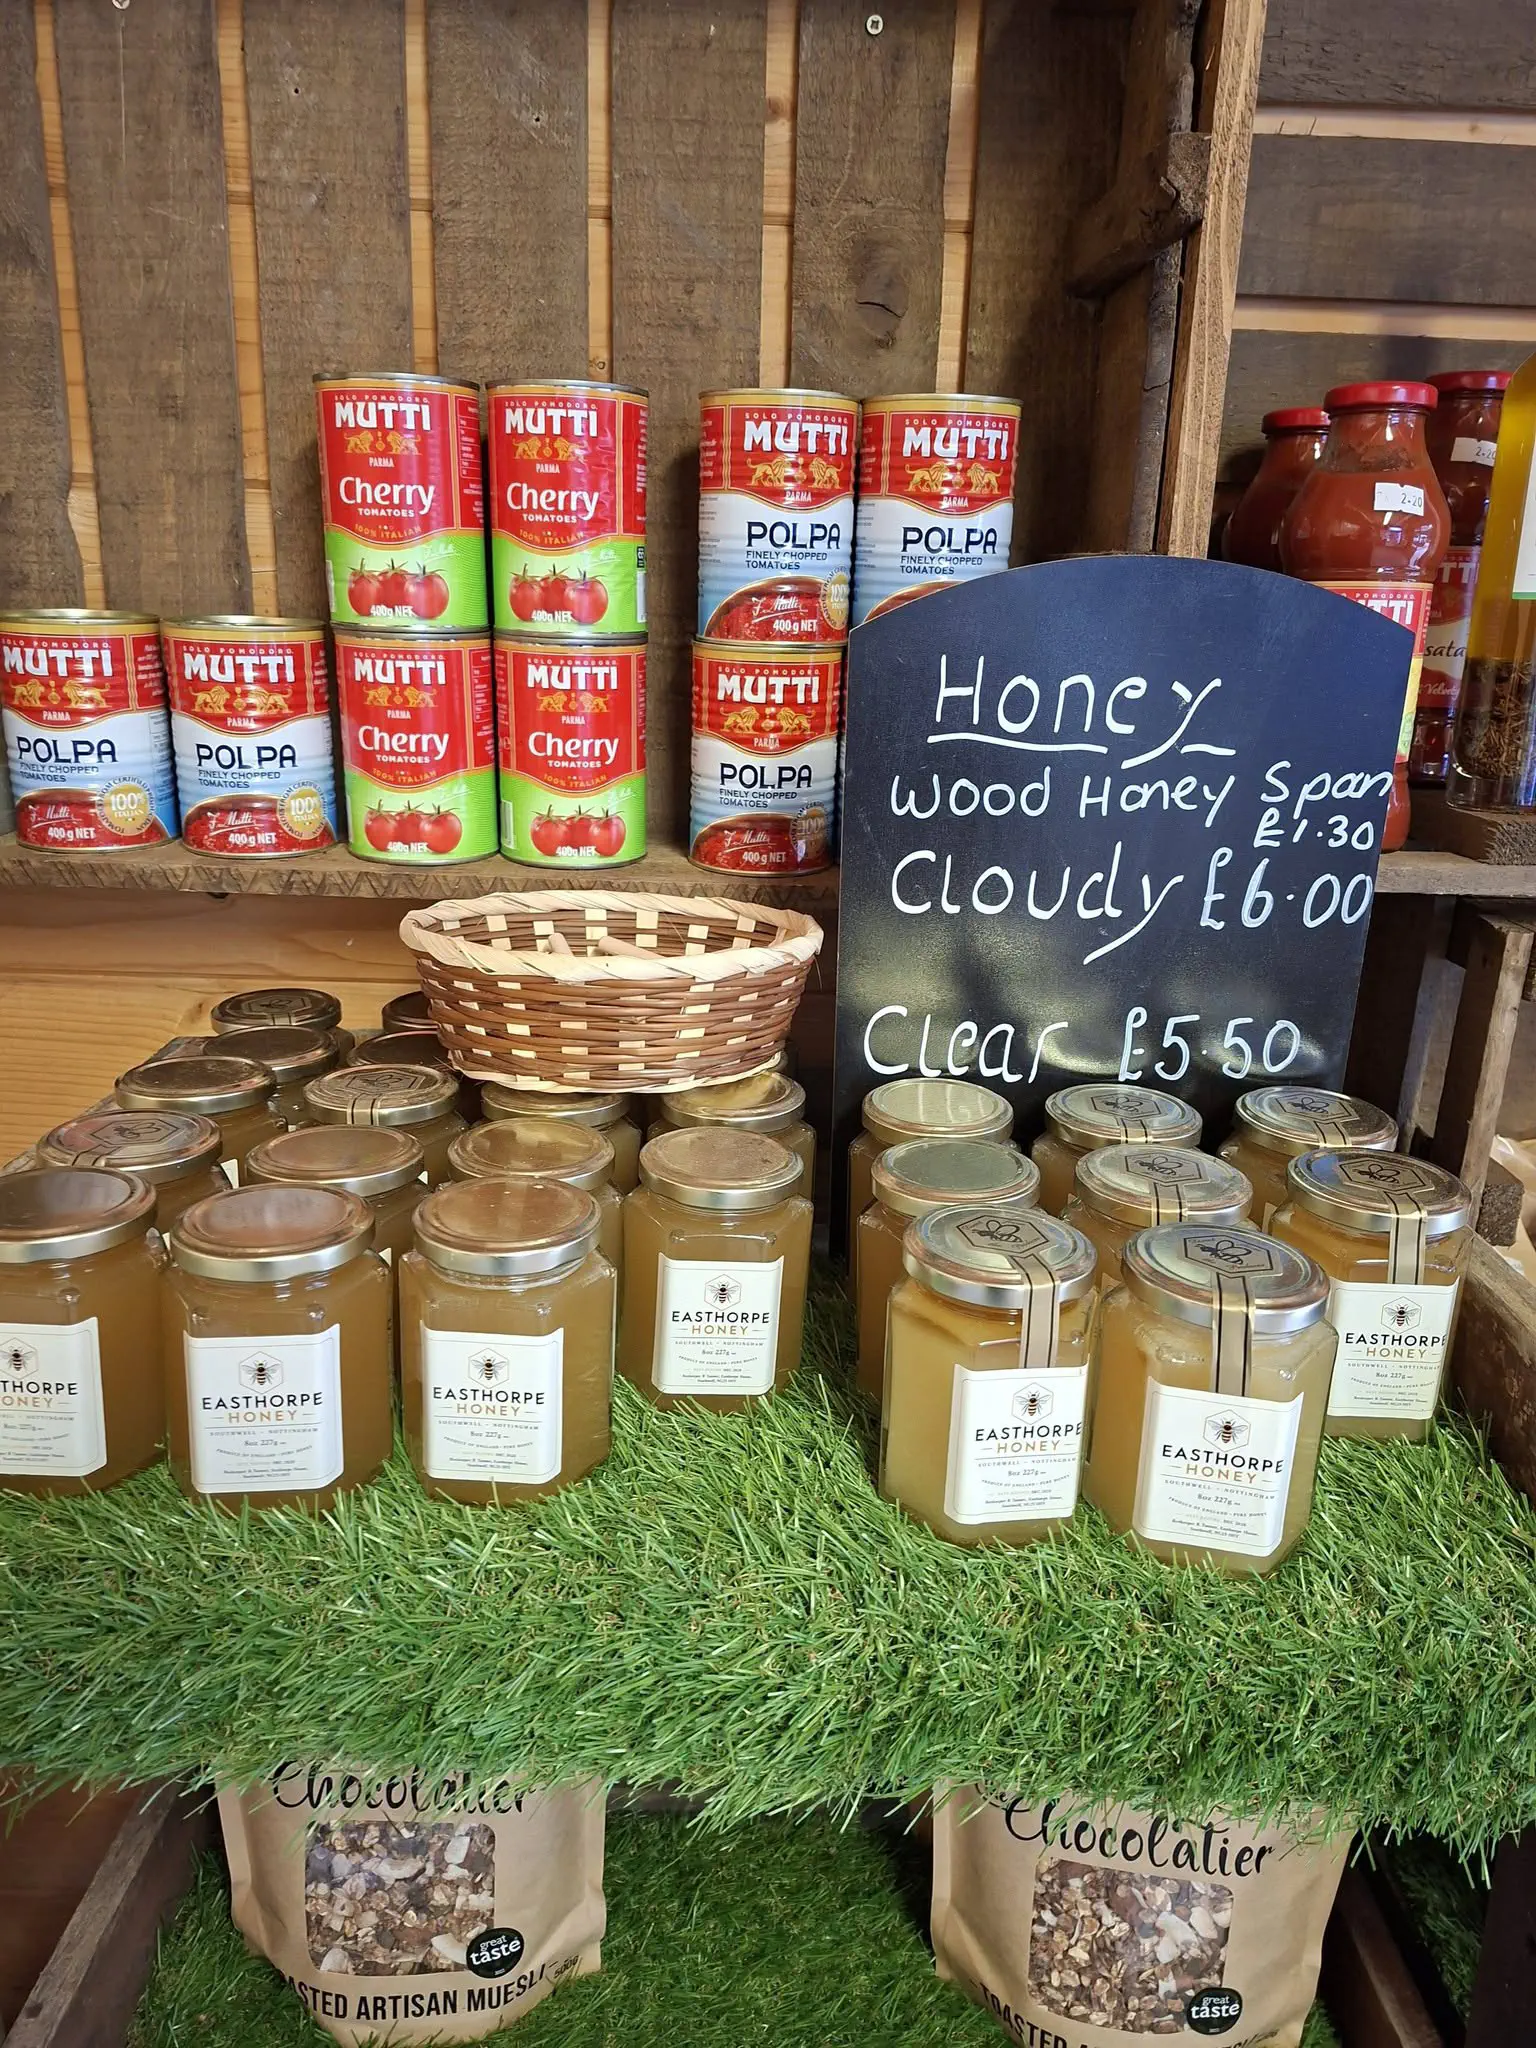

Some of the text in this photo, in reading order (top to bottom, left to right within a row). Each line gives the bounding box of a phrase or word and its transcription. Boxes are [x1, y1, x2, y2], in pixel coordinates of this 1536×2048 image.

[335, 402, 431, 431] MUTTI
[505, 407, 598, 437] MUTTI
[744, 421, 848, 455] MUTTI
[903, 426, 1009, 460] MUTTI
[369, 456, 394, 468] PARMA
[536, 463, 560, 474] PARMA
[339, 476, 435, 515] Cherry
[506, 482, 599, 521] Cherry
[785, 490, 812, 502] PARMA
[942, 496, 969, 508] PARMA
[1401, 492, 1423, 508] 2.20
[358, 507, 415, 518] TOMATOES
[522, 513, 577, 523] TOMATOES
[746, 521, 841, 550] POLPA
[901, 527, 997, 554] POLPA
[746, 551, 827, 561] FINELY CHOPPED
[901, 556, 982, 566] FINELY CHOPPED
[745, 560, 800, 571] TOMATOES
[900, 566, 954, 575] TOMATOES
[1439, 562, 1480, 584] TTI
[801, 619, 818, 632] NET
[1423, 641, 1465, 658] sata
[1, 645, 113, 677] MUTTI
[184, 652, 295, 683] MUTTI
[354, 658, 445, 685] MUTTI
[527, 664, 617, 690] MUTTI
[717, 673, 819, 704] MUTTI
[387, 709, 411, 720] PARMA
[934, 655, 1222, 769] Honey
[561, 715, 585, 725] PARMA
[16, 736, 118, 763] POLPA
[358, 725, 450, 761] Cherry
[528, 731, 619, 765] Cherry
[753, 737, 780, 748] PARMA
[195, 743, 297, 769] POLPA
[376, 754, 430, 764] TOMATOES
[20, 763, 99, 774] FINELY CHOPPED
[548, 760, 601, 768] TOMATOES
[20, 771, 66, 782] TOMATOES
[199, 769, 280, 780] FINELY CHOPPED
[720, 762, 812, 789] POLPA
[199, 778, 250, 788] TOMATOES
[719, 789, 797, 800] FINELY CHOPPED
[1079, 774, 1236, 828] Honey
[719, 797, 768, 808] TOMATOES
[75, 828, 95, 838] NET
[1253, 806, 1375, 850] £1.30
[257, 833, 277, 844] NET
[769, 852, 786, 863] NET
[890, 841, 1374, 965] Cloudy £6.00
[862, 1004, 1302, 1084] Clear £5.50
[672, 1311, 770, 1324] EASTHORPE
[692, 1325, 748, 1335] HONEY
[1366, 1348, 1427, 1358] HONEY
[0, 1380, 78, 1395] THORPE
[3, 1396, 53, 1408] ONEY
[202, 1392, 323, 1410] EASTHORPE
[433, 1387, 545, 1405] EASTHORPE
[228, 1410, 298, 1424] HONEY
[457, 1403, 520, 1417] HONEY
[997, 1440, 1060, 1454] HONEY
[1162, 1444, 1284, 1473] EASTHORPE
[1186, 1463, 1257, 1484] HONEY
[480, 1935, 507, 1952] great
[470, 1938, 521, 1965] taste
[289, 1964, 546, 2019] ASTED ARTISAN MUESLI
[1202, 1996, 1230, 2007] great
[1191, 2003, 1240, 2019] taste
